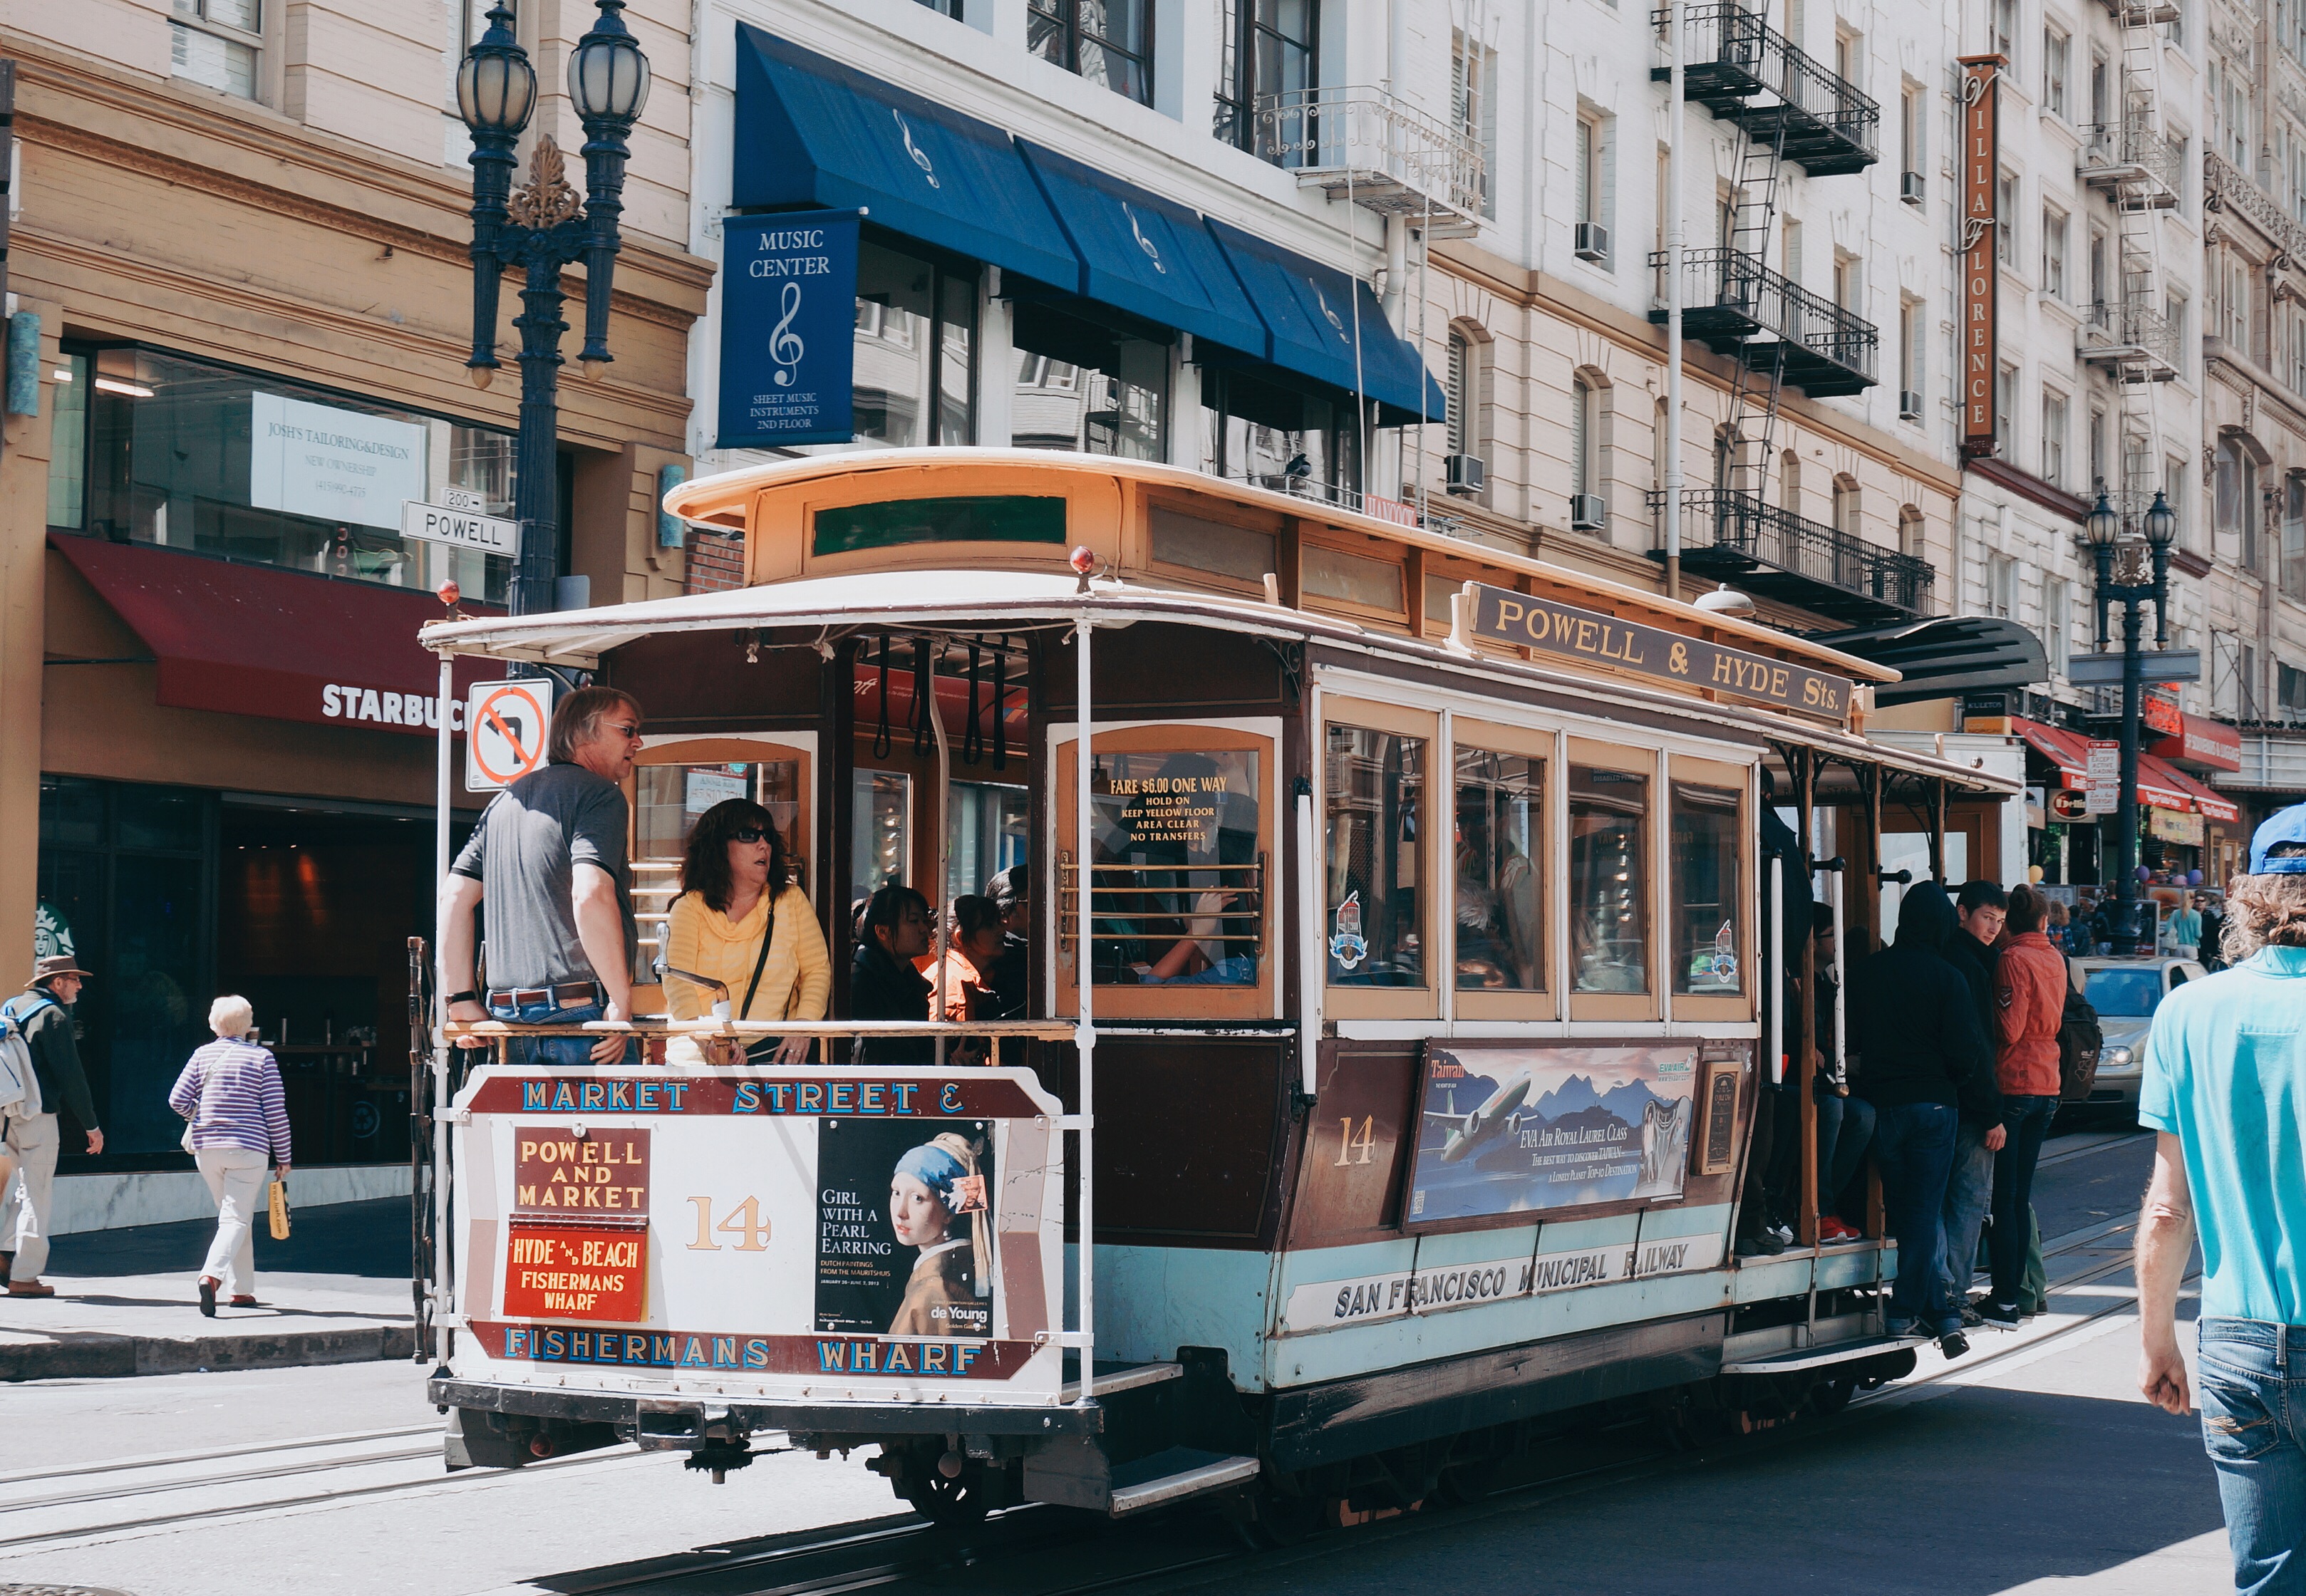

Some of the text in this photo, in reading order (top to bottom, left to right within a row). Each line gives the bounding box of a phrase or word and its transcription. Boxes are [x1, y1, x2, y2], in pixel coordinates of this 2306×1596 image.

[1964, 72, 2000, 212] VILLA
[759, 229, 824, 250] MUSIC
[750, 256, 830, 278] CENTER
[1963, 217, 1995, 423] FLORENCE
[753, 393, 817, 404] SHEET MUSIC
[750, 405, 819, 418] INSTRUMENTS
[268, 422, 303, 440] JOSH'S
[757, 419, 812, 429] 2ND FLOOR
[305, 455, 377, 477] NEW OWNERSHIP
[448, 492, 469, 507] 200
[426, 514, 502, 546] POWELL
[1496, 599, 1839, 711] POWELL & HYDE Sts.
[322, 684, 470, 732] STARBUC
[1110, 777, 1227, 794] FARE $6.00 ONE WAY
[1146, 796, 1190, 806] HOLD ON
[1122, 807, 1215, 818] KEEP YELLOW FLOOR
[1136, 819, 1199, 829] AREA CLEAR
[1130, 831, 1206, 841] NO TRANSFERS
[1432, 1059, 1464, 1078] Taiwan
[522, 1080, 689, 1111] MARKET
[733, 1080, 919, 1114] STREET
[1334, 1114, 1377, 1166] 14
[1520, 1123, 1628, 1149] EVA AIR ROYAL LAUREL CLASS
[521, 1141, 642, 1164] POWELL
[1532, 1153, 1542, 1167] THE
[1543, 1154, 1554, 1166] BEST
[1555, 1154, 1567, 1164] WAY
[1567, 1153, 1574, 1164] TO
[1574, 1151, 1598, 1163] DISCOVER
[551, 1166, 611, 1184] AND
[1552, 1171, 1570, 1183] LONELY
[1570, 1170, 1587, 1181] PLANET
[1587, 1164, 1604, 1179] TOP-10
[1604, 1163, 1638, 1177] DESTINATION
[519, 1185, 644, 1208] MARKET
[822, 1188, 860, 1205] GIRL
[686, 1195, 772, 1252] 14
[822, 1208, 878, 1221] WITH A
[822, 1222, 870, 1238] PEARL
[513, 1238, 638, 1268] HYDE AND BEACH
[821, 1238, 891, 1255] EARRING
[520, 1271, 625, 1292] FISHERMANS
[544, 1292, 597, 1310] WHARF
[1335, 1282, 1382, 1318] SAN
[1387, 1266, 1506, 1310] FRANCISCO
[931, 1306, 988, 1323] de Young
[505, 1327, 981, 1376] FISHERMANS WHARF
